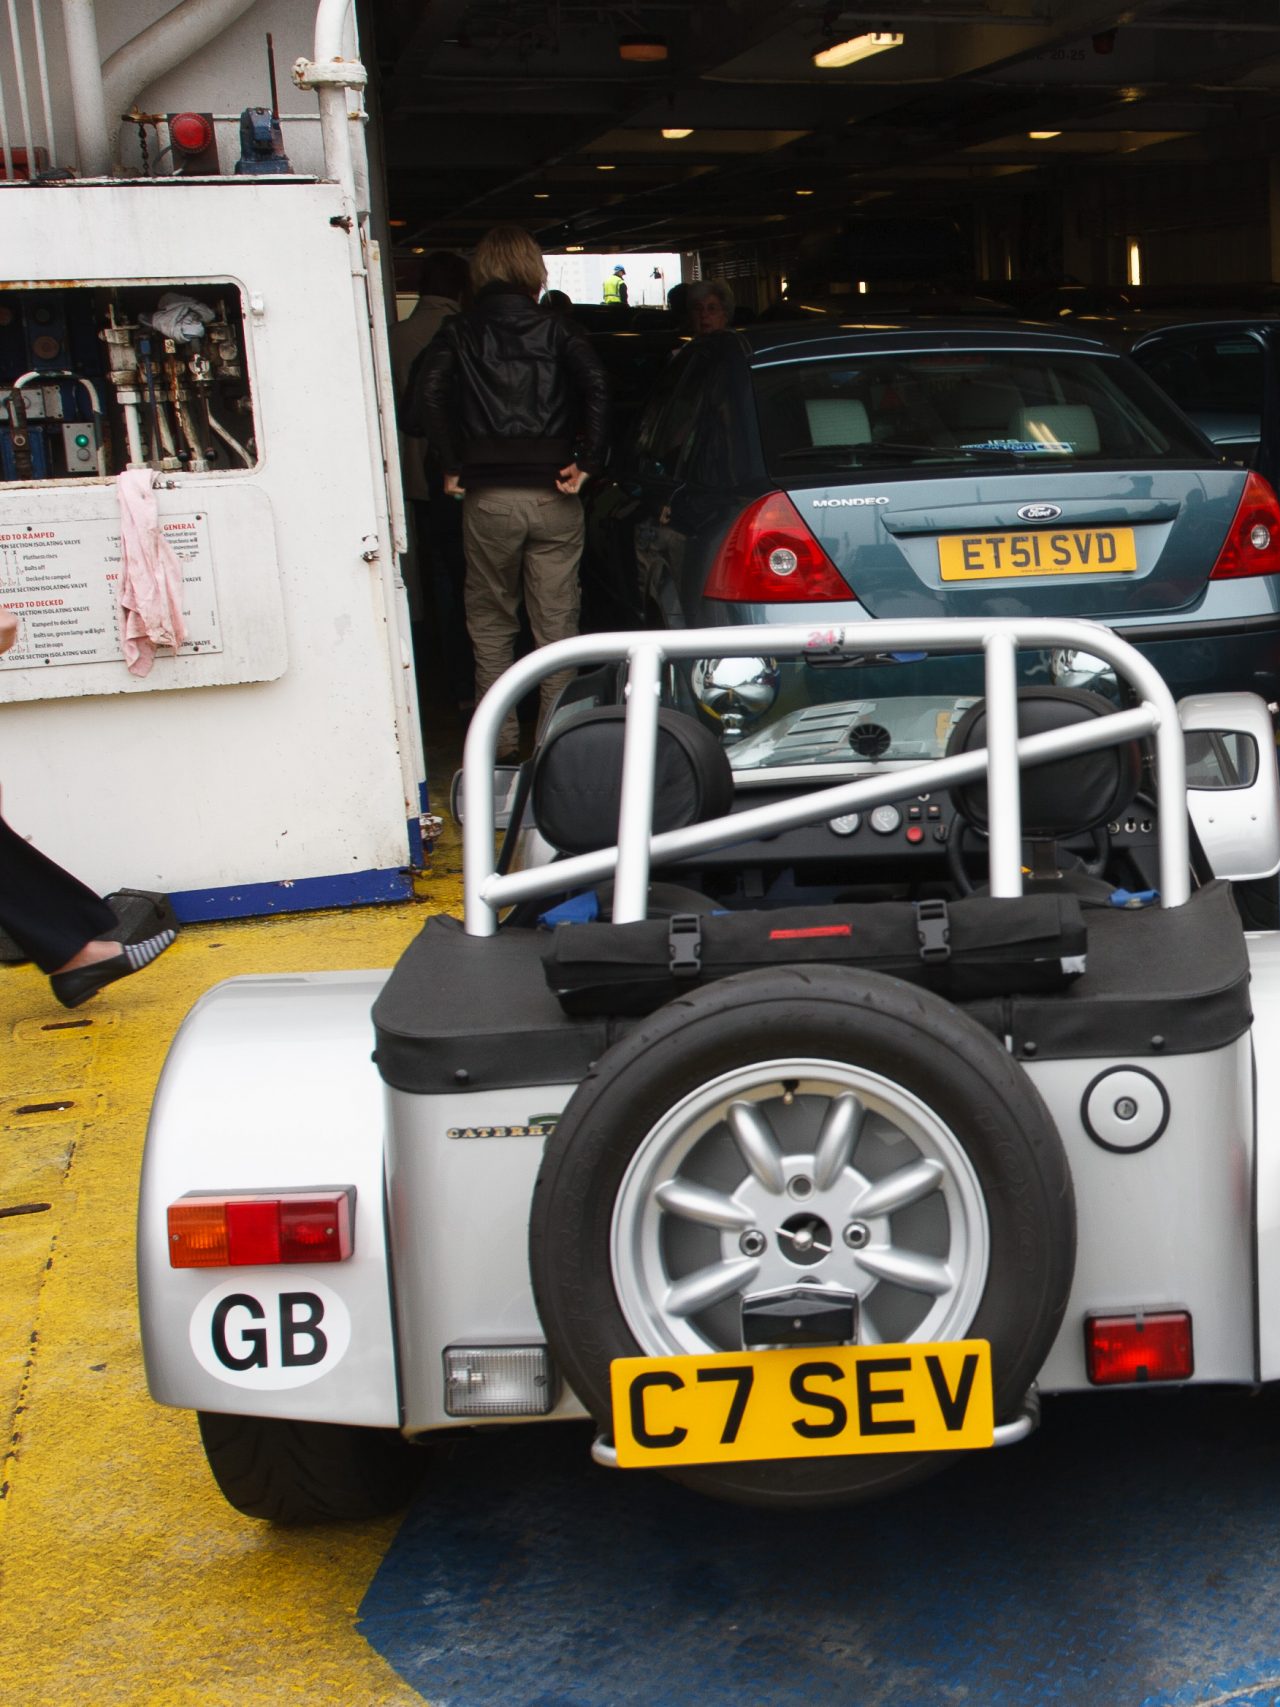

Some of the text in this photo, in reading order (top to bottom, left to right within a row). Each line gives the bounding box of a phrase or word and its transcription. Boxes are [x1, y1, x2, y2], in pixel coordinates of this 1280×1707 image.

[812, 496, 890, 508] MONDEO
[1027, 506, 1052, 518] Ford
[163, 523, 196, 531] GENERAL
[962, 532, 1117, 571] ET51 SVD
[36, 599, 64, 607] DECKED
[211, 1291, 329, 1372] GB
[628, 1353, 981, 1449] C7 SEV
